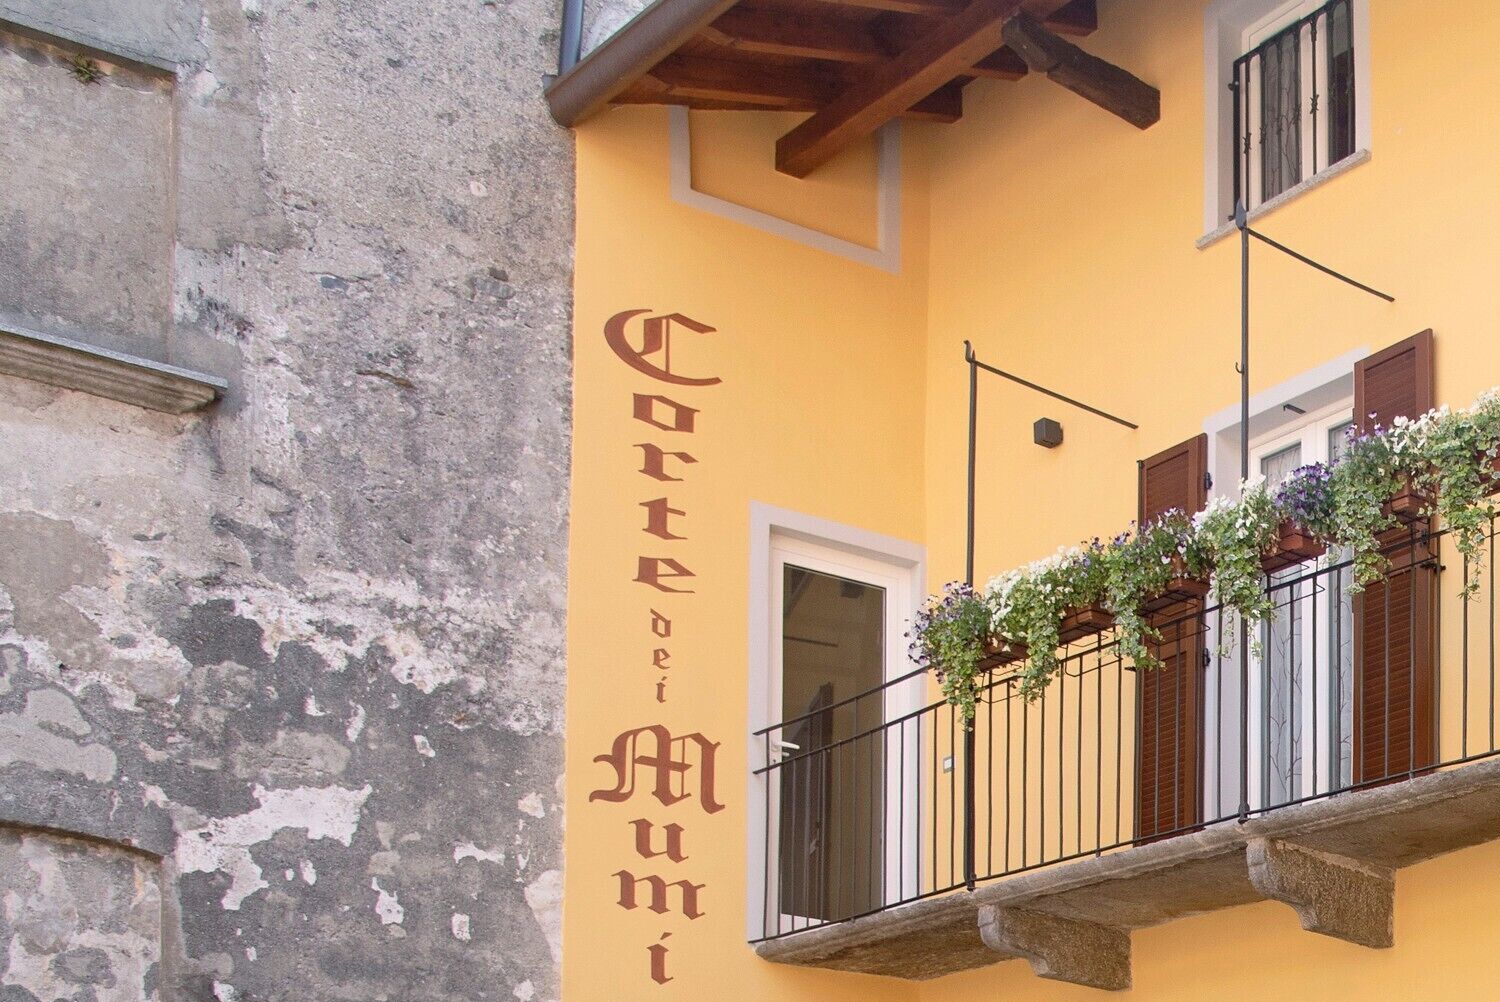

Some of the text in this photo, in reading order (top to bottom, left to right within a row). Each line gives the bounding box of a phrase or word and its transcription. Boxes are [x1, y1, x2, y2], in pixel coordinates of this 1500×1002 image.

[588, 308, 726, 986] Corte dei Mumi
